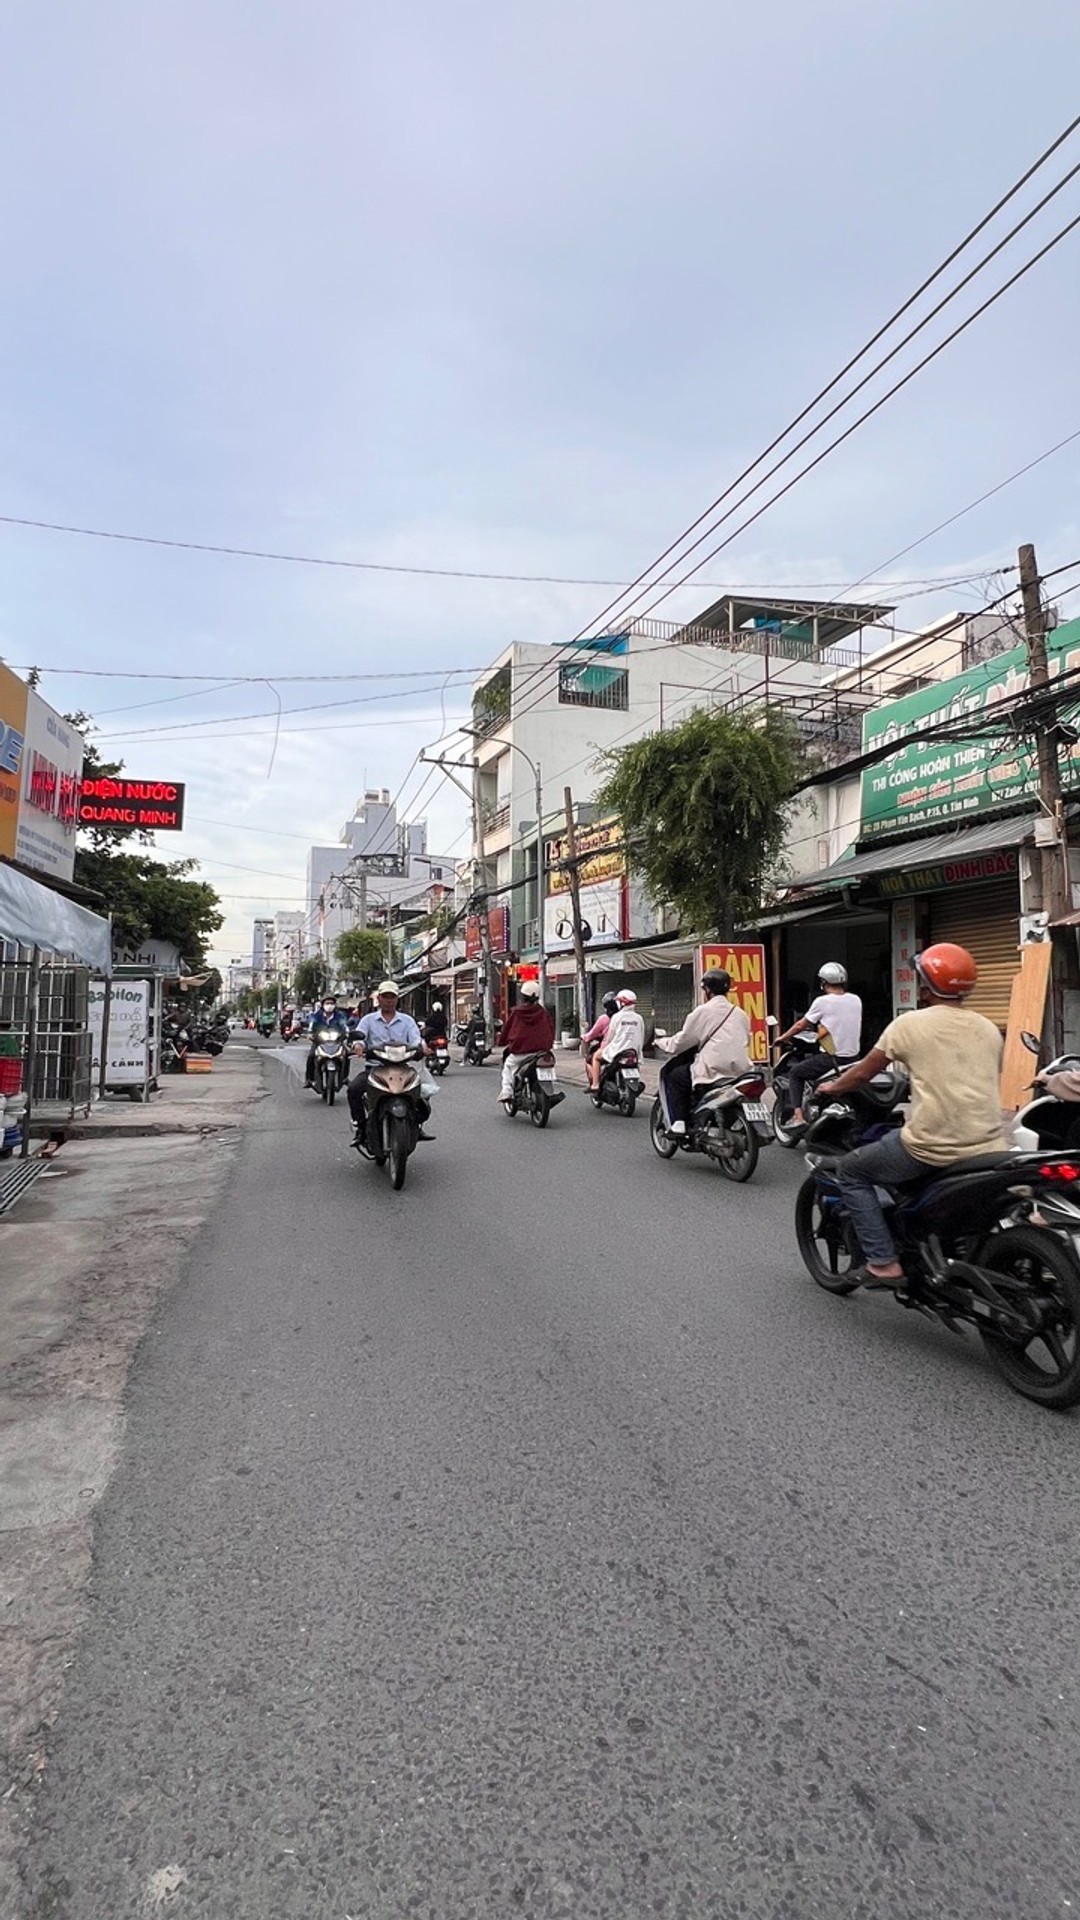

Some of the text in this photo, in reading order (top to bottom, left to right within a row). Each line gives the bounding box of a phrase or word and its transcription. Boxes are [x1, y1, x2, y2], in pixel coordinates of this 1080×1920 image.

[872, 776, 887, 792] THI
[888, 766, 918, 787] CÔNG
[919, 755, 951, 779] HOÀN
[952, 743, 986, 766] THIỆN
[82, 778, 178, 801] ĐIỆN NƯỚC
[80, 805, 176, 825] QUANG MINH
